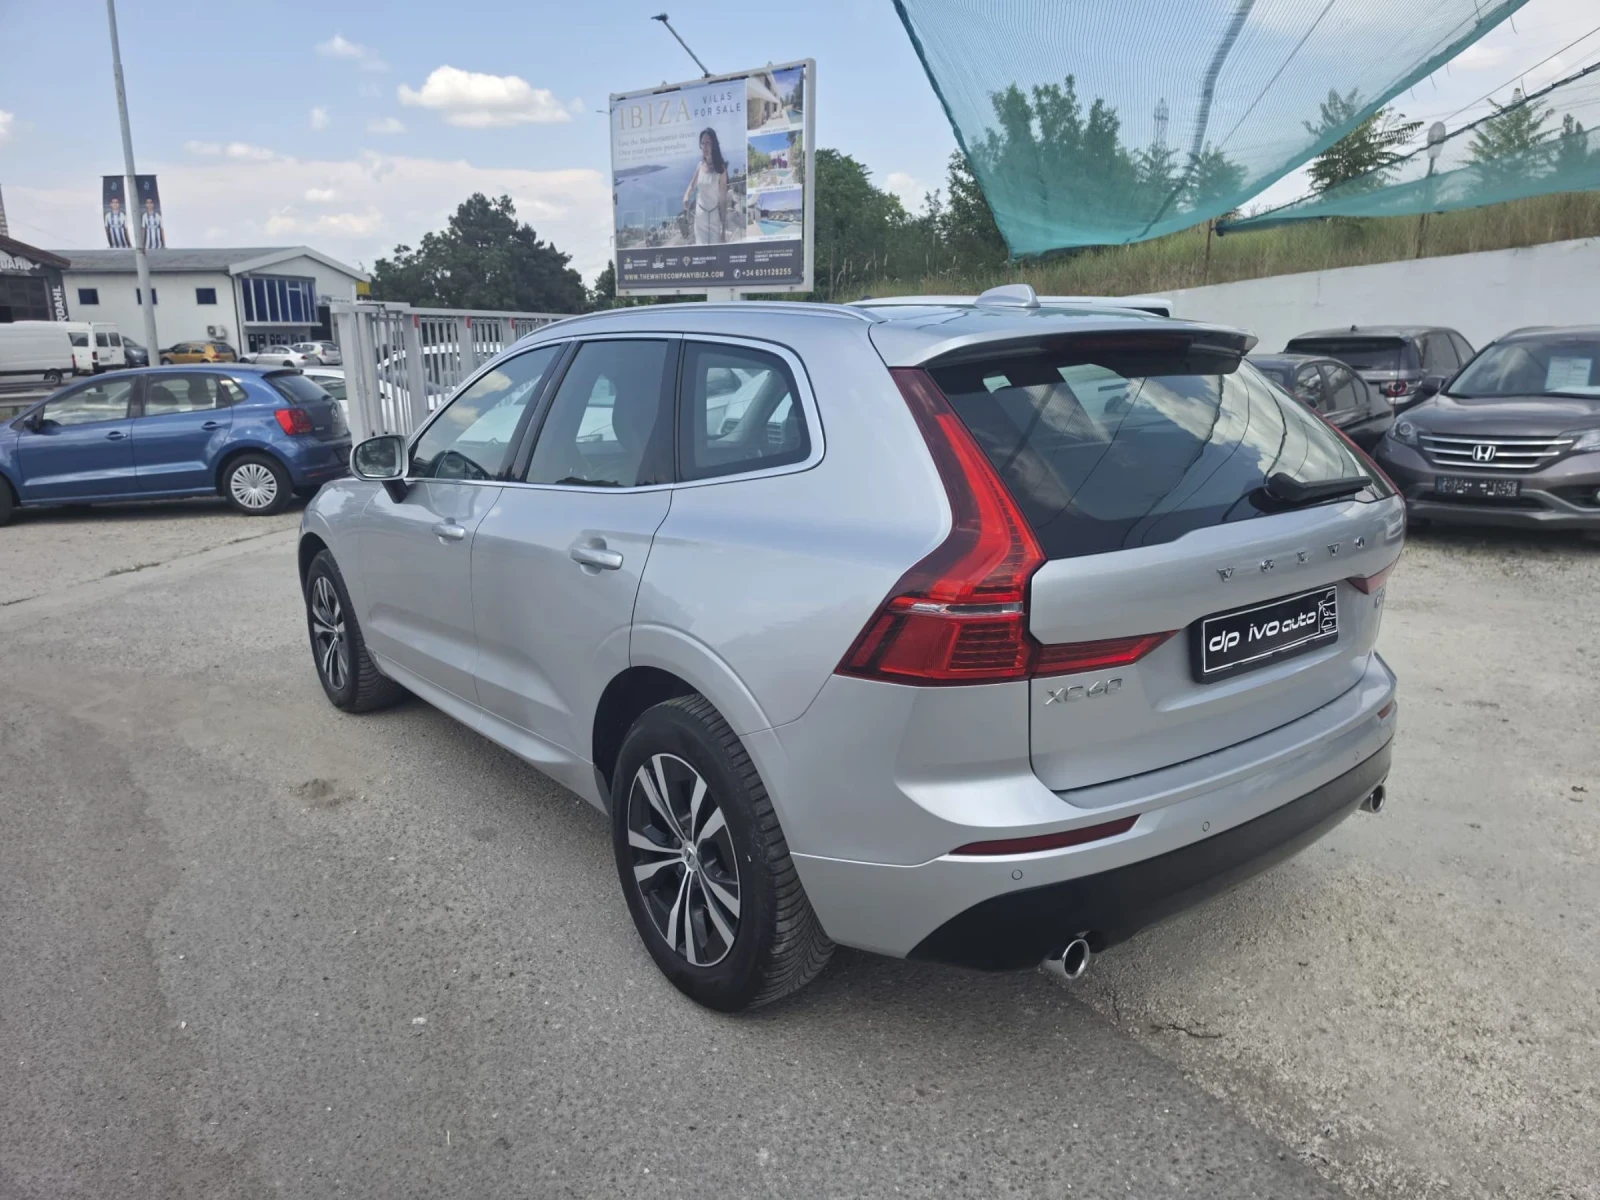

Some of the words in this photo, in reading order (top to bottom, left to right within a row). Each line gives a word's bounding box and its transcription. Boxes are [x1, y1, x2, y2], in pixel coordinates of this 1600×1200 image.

[694, 105, 713, 118] FOR
[716, 102, 741, 115] SALE
[702, 91, 732, 104] VILAS
[619, 100, 690, 130] IBIZA
[624, 271, 724, 281] WWW.THEWHITECOMPANYIBIZA.COM
[1216, 536, 1365, 582] VOLVO
[1209, 630, 1240, 653] dp
[1248, 619, 1280, 642] ivo
[1281, 611, 1317, 632] auto
[1045, 678, 1123, 705] XC60
